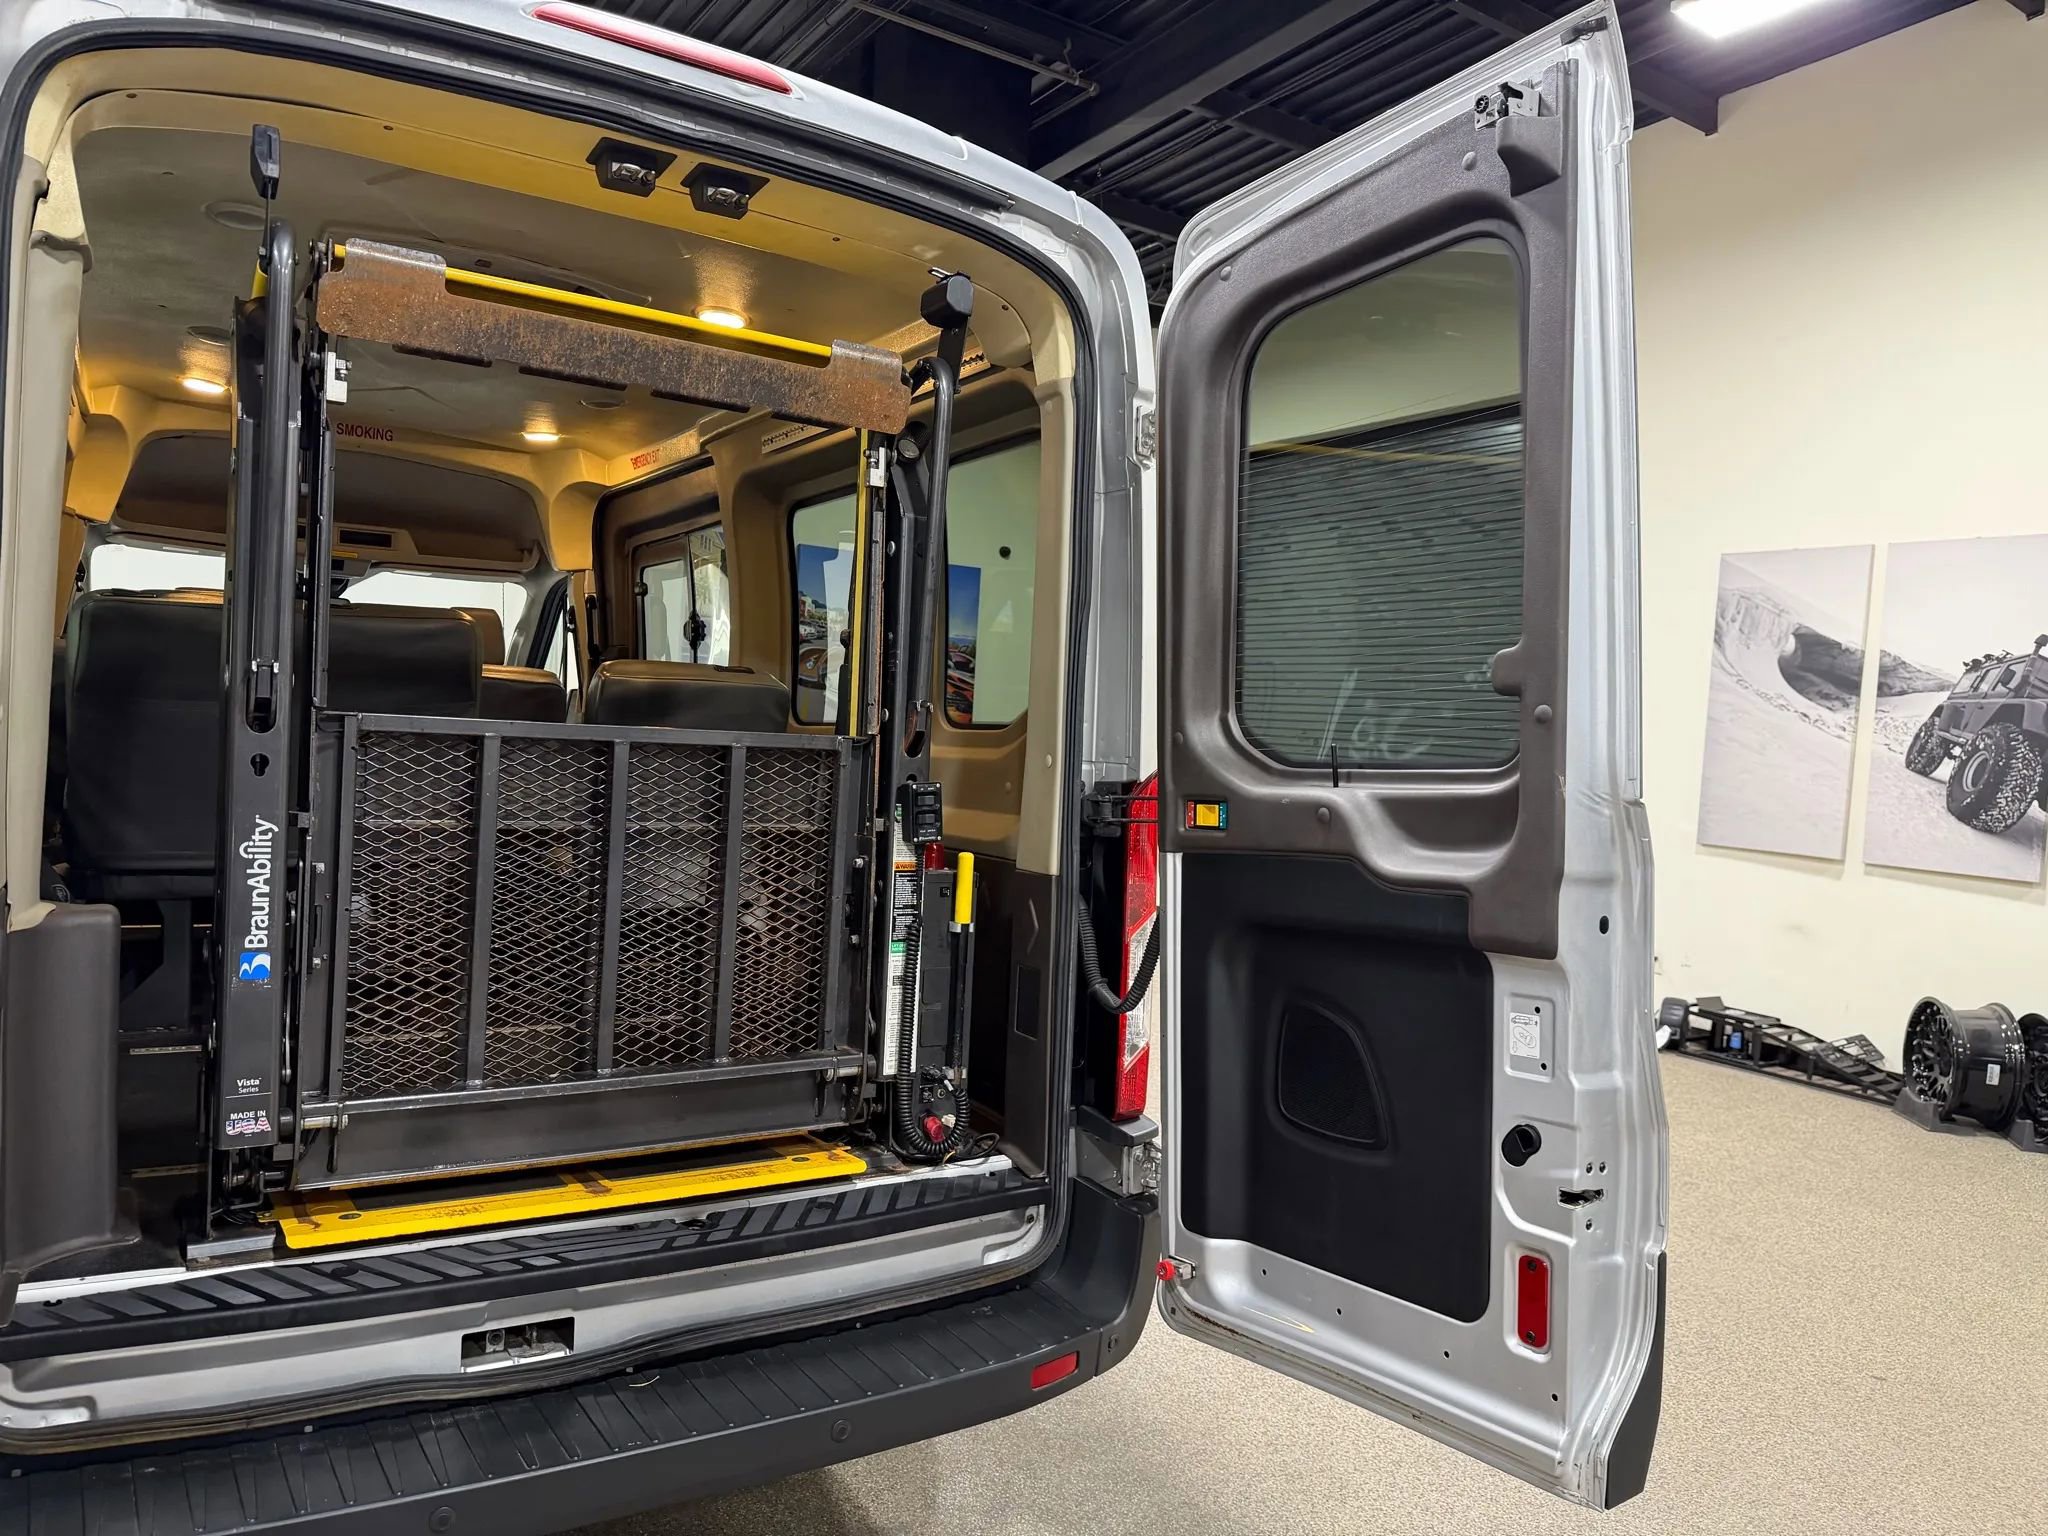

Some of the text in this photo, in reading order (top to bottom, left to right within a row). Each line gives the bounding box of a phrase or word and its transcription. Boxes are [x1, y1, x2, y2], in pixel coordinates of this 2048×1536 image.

[336, 422, 393, 441] SMOKING
[239, 818, 279, 949] BraunAbility
[237, 1078, 260, 1087] Vista
[230, 1110, 266, 1120] MADE IN
[225, 1117, 271, 1135] USA
